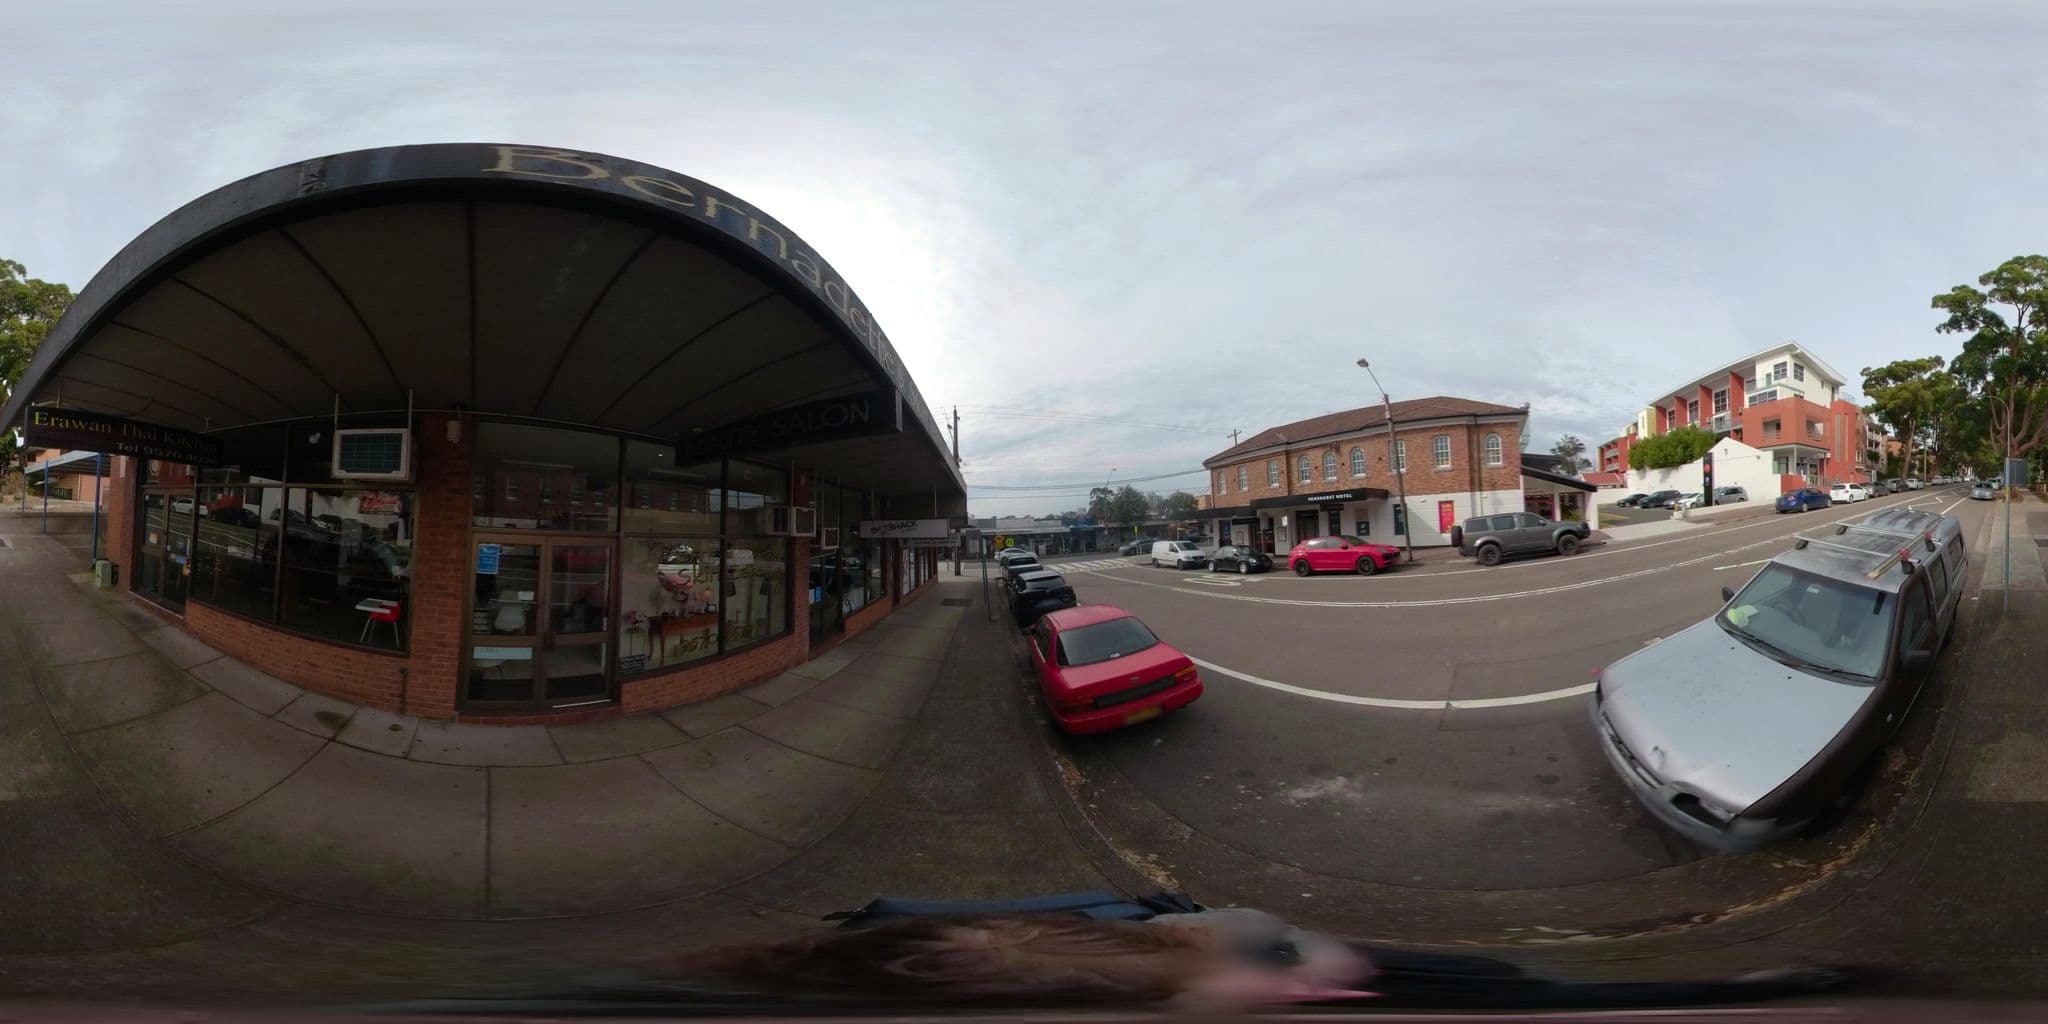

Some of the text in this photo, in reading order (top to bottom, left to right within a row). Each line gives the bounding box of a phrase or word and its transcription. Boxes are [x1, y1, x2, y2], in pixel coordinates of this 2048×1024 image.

[32, 411, 112, 432] Erawan
[120, 423, 156, 441] Thai
[771, 399, 870, 438] SALON
[116, 441, 139, 453] Tel
